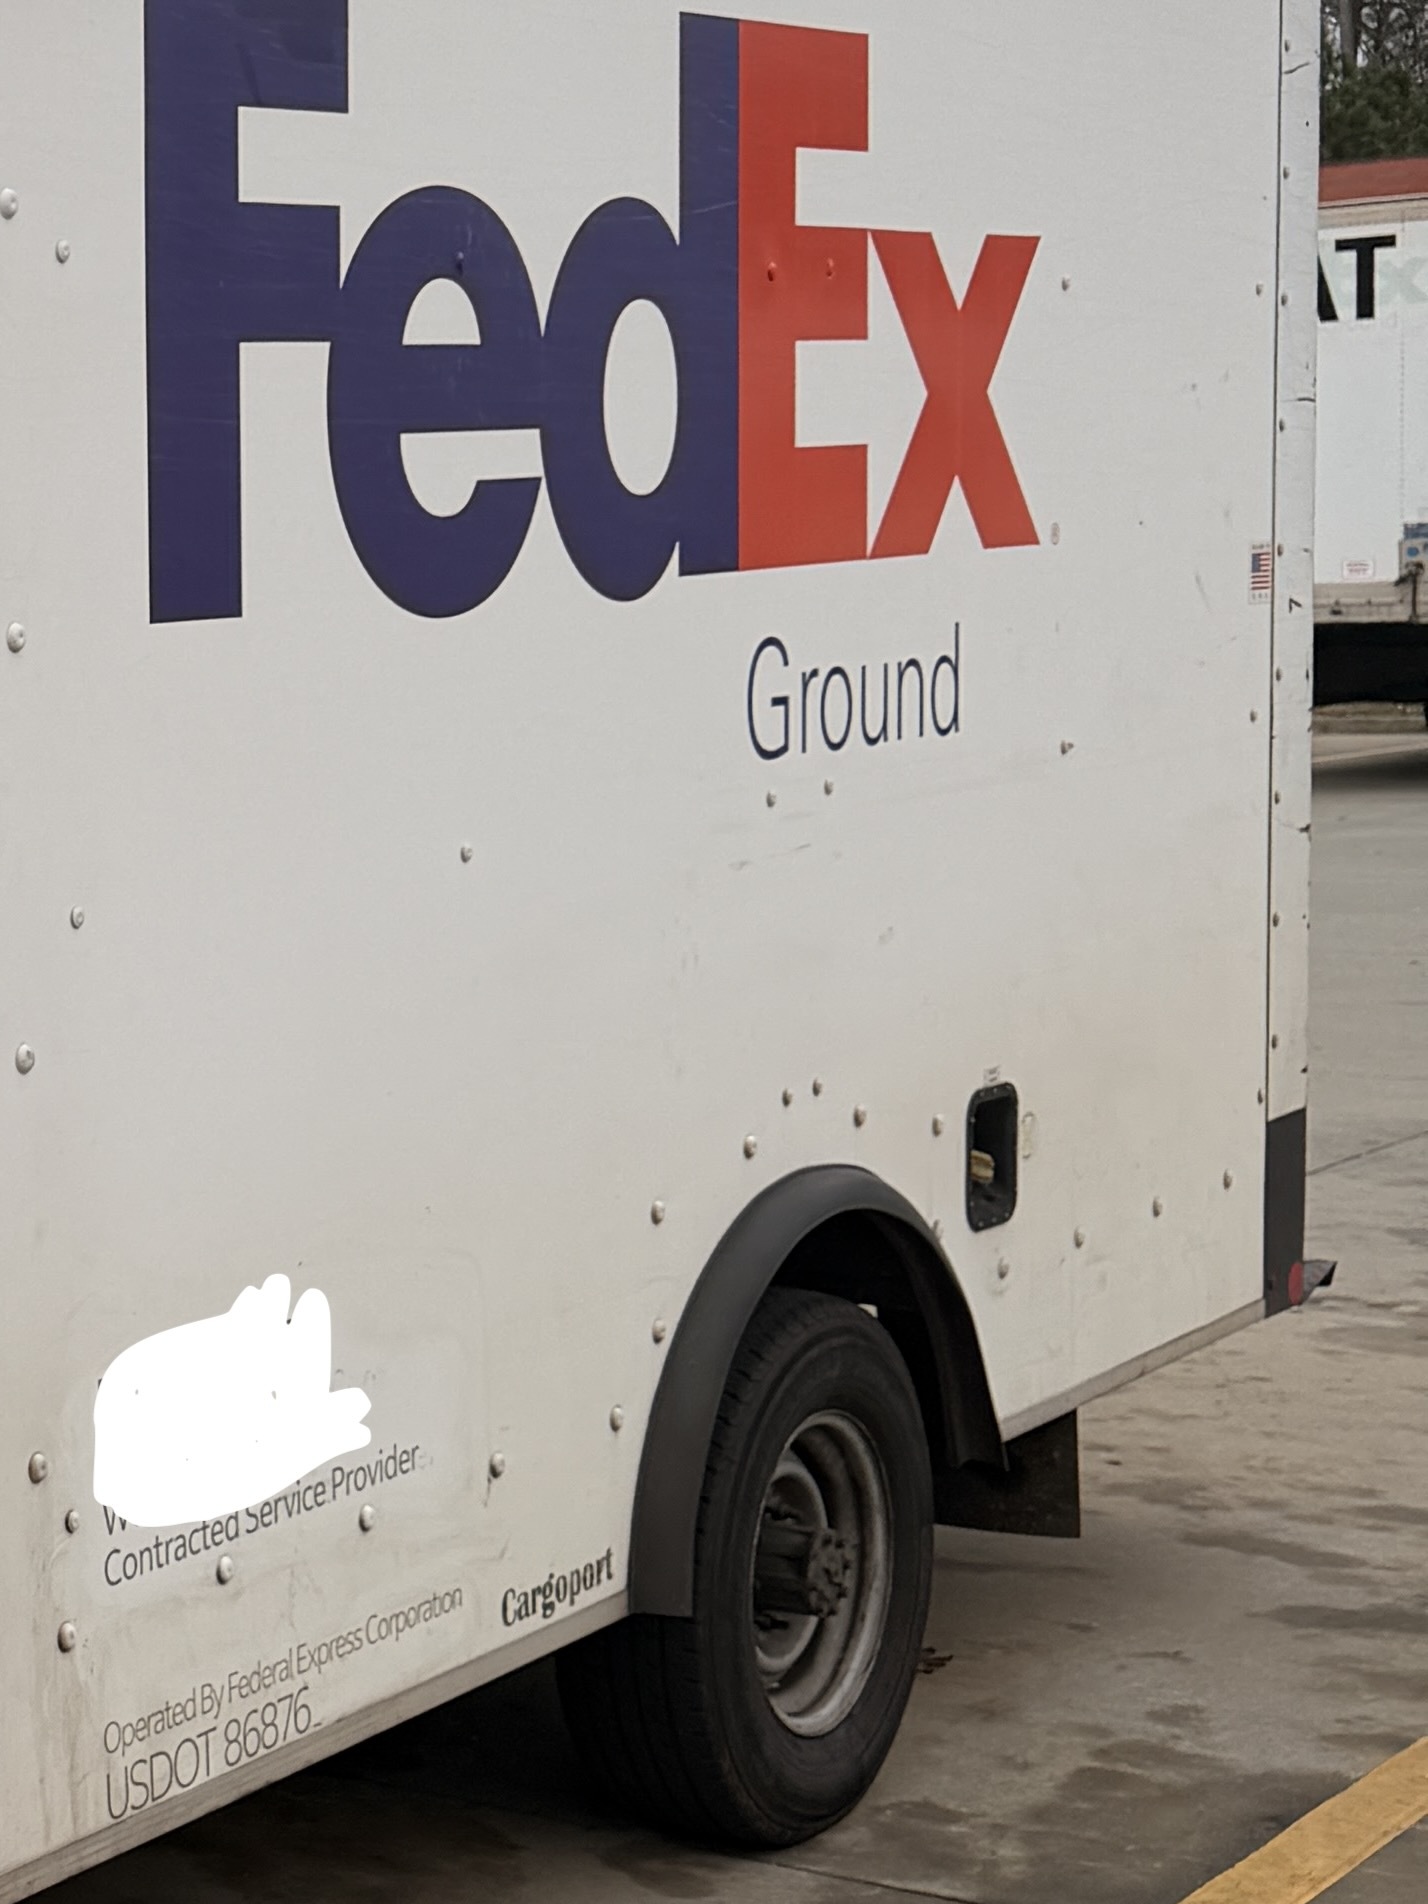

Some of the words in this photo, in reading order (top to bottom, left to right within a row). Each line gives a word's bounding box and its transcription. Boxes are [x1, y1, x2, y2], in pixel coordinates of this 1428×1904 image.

[745, 621, 962, 761] Ground
[103, 1509, 240, 1587] Contracted
[245, 1479, 327, 1535] Service
[331, 1443, 421, 1501] Provider
[501, 1546, 614, 1627] Cargoport
[103, 1687, 196, 1757] Operated
[199, 1682, 226, 1721] By
[227, 1647, 294, 1704] Federal
[296, 1626, 364, 1675] Express
[364, 1587, 464, 1643] Corporation
[106, 1726, 218, 1820] USDOT
[223, 1685, 313, 1768] 86876
